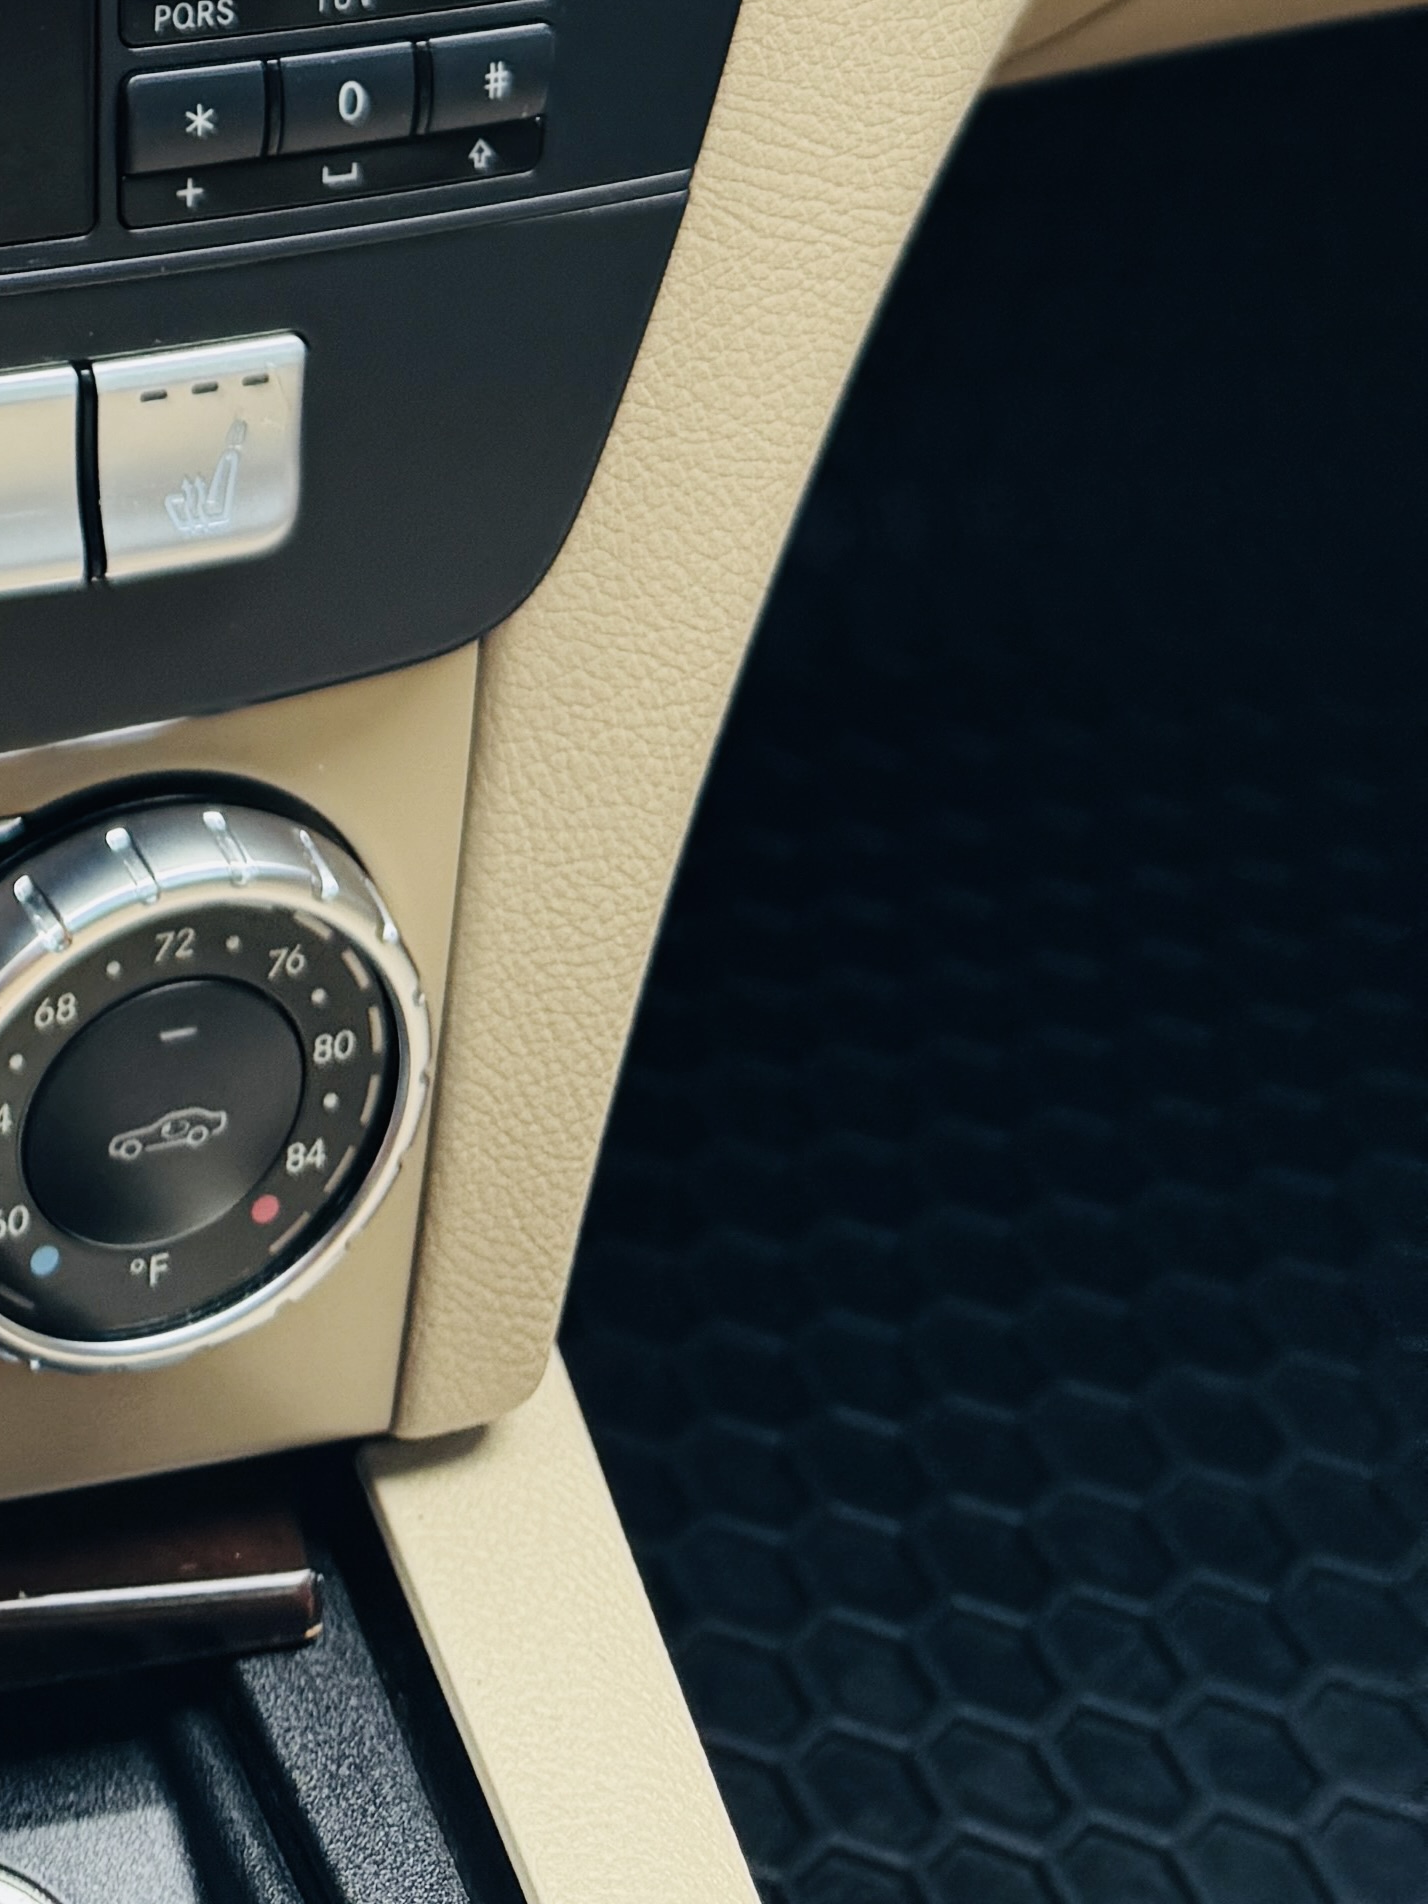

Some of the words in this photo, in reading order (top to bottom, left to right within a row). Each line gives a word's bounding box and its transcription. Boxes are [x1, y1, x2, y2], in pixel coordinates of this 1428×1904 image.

[156, 928, 195, 962] 72
[269, 944, 305, 979] 76
[35, 993, 77, 1027] 68
[313, 1030, 356, 1064] 80
[286, 1138, 325, 1174] 84
